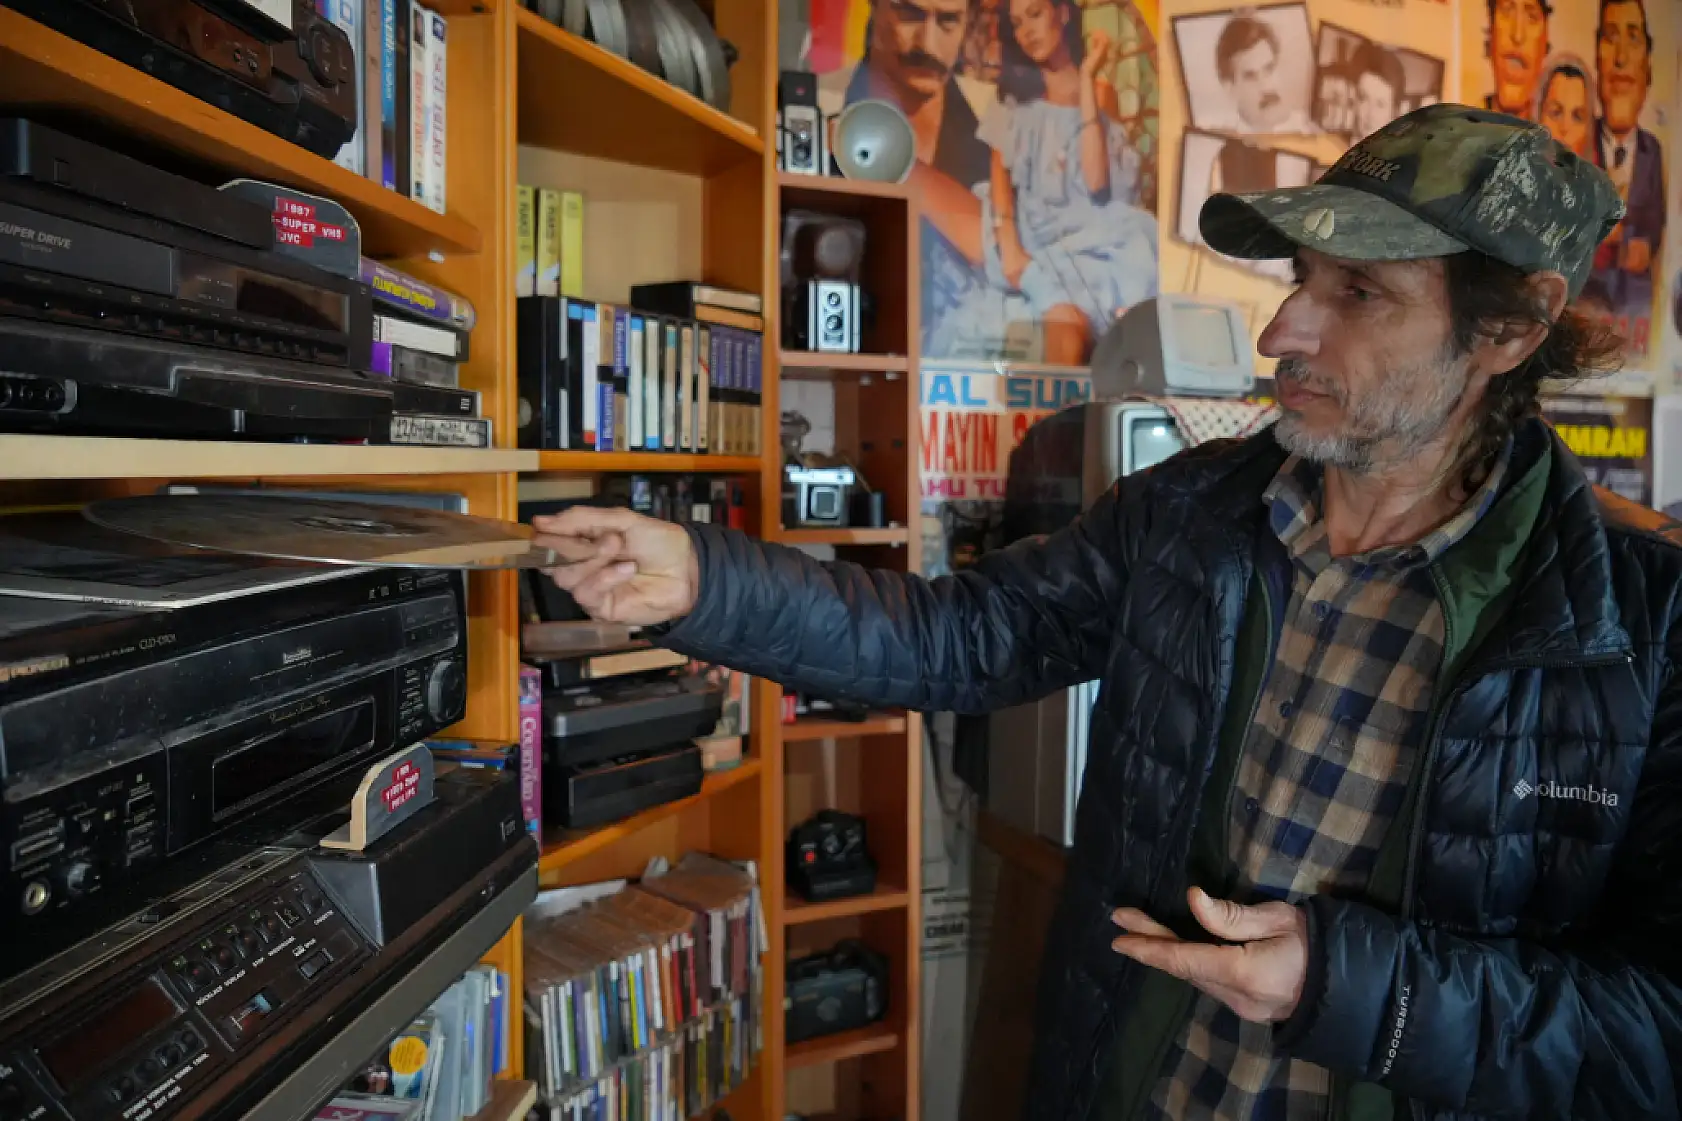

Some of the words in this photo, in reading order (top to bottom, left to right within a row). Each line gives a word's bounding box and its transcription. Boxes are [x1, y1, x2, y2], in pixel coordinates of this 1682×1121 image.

[0, 221, 35, 239] SUPER
[37, 231, 73, 249] DRIVE
[279, 231, 301, 245] JVC
[281, 217, 317, 233] SUPER
[321, 227, 342, 240] VHS
[919, 371, 988, 406] AL
[919, 478, 967, 497] HU
[1381, 984, 1412, 1075] TURBODOWN
